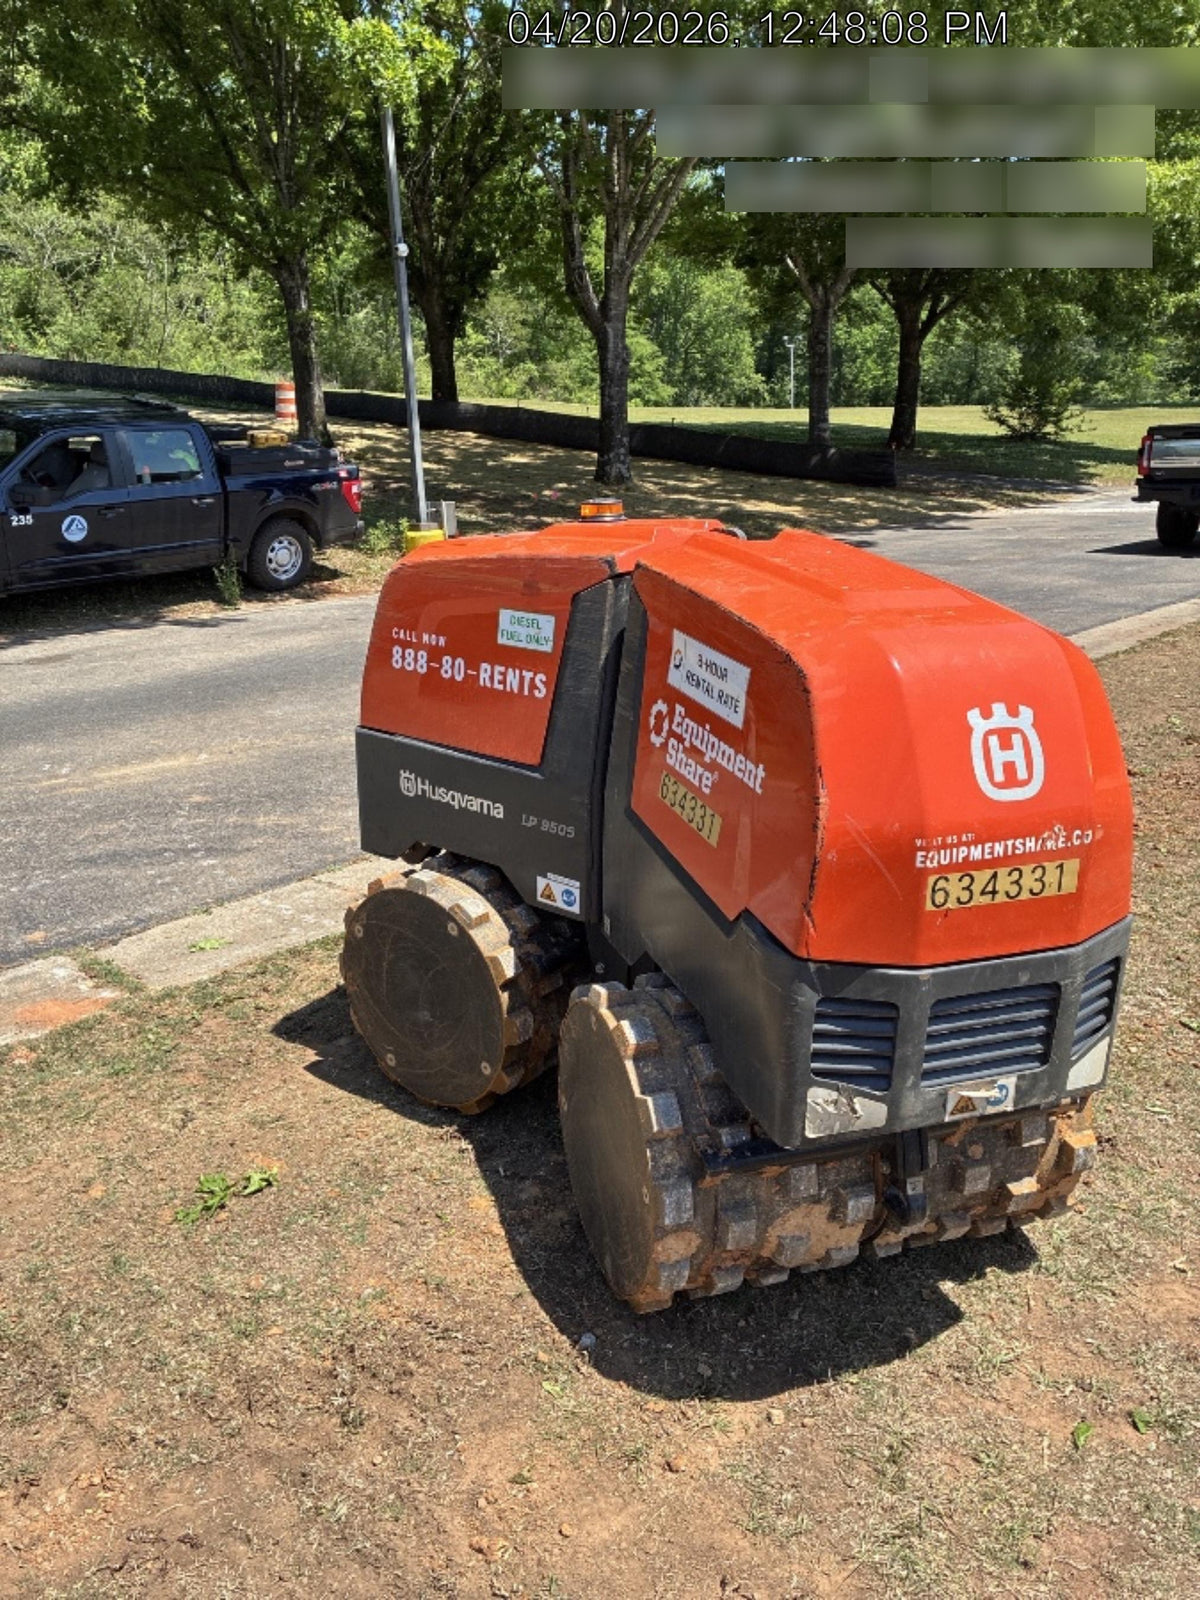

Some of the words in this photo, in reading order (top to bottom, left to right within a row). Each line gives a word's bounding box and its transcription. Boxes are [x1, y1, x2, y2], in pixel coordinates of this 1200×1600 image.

[10, 515, 33, 526] 235
[392, 627, 417, 642] CALL
[422, 632, 447, 647] NOW
[501, 629, 523, 643] FUEL
[526, 634, 551, 646] ONLY
[510, 615, 542, 631] DIESEL
[392, 645, 547, 698] 888-80-RENTS
[686, 669, 714, 699] RENTAL
[718, 689, 740, 714] RATE
[672, 703, 766, 795] Equipment
[417, 776, 504, 819] Husqvarna
[661, 773, 716, 841] 634331
[521, 814, 537, 827] LP
[961, 833, 976, 843] AT:
[930, 862, 1066, 909] 634331
